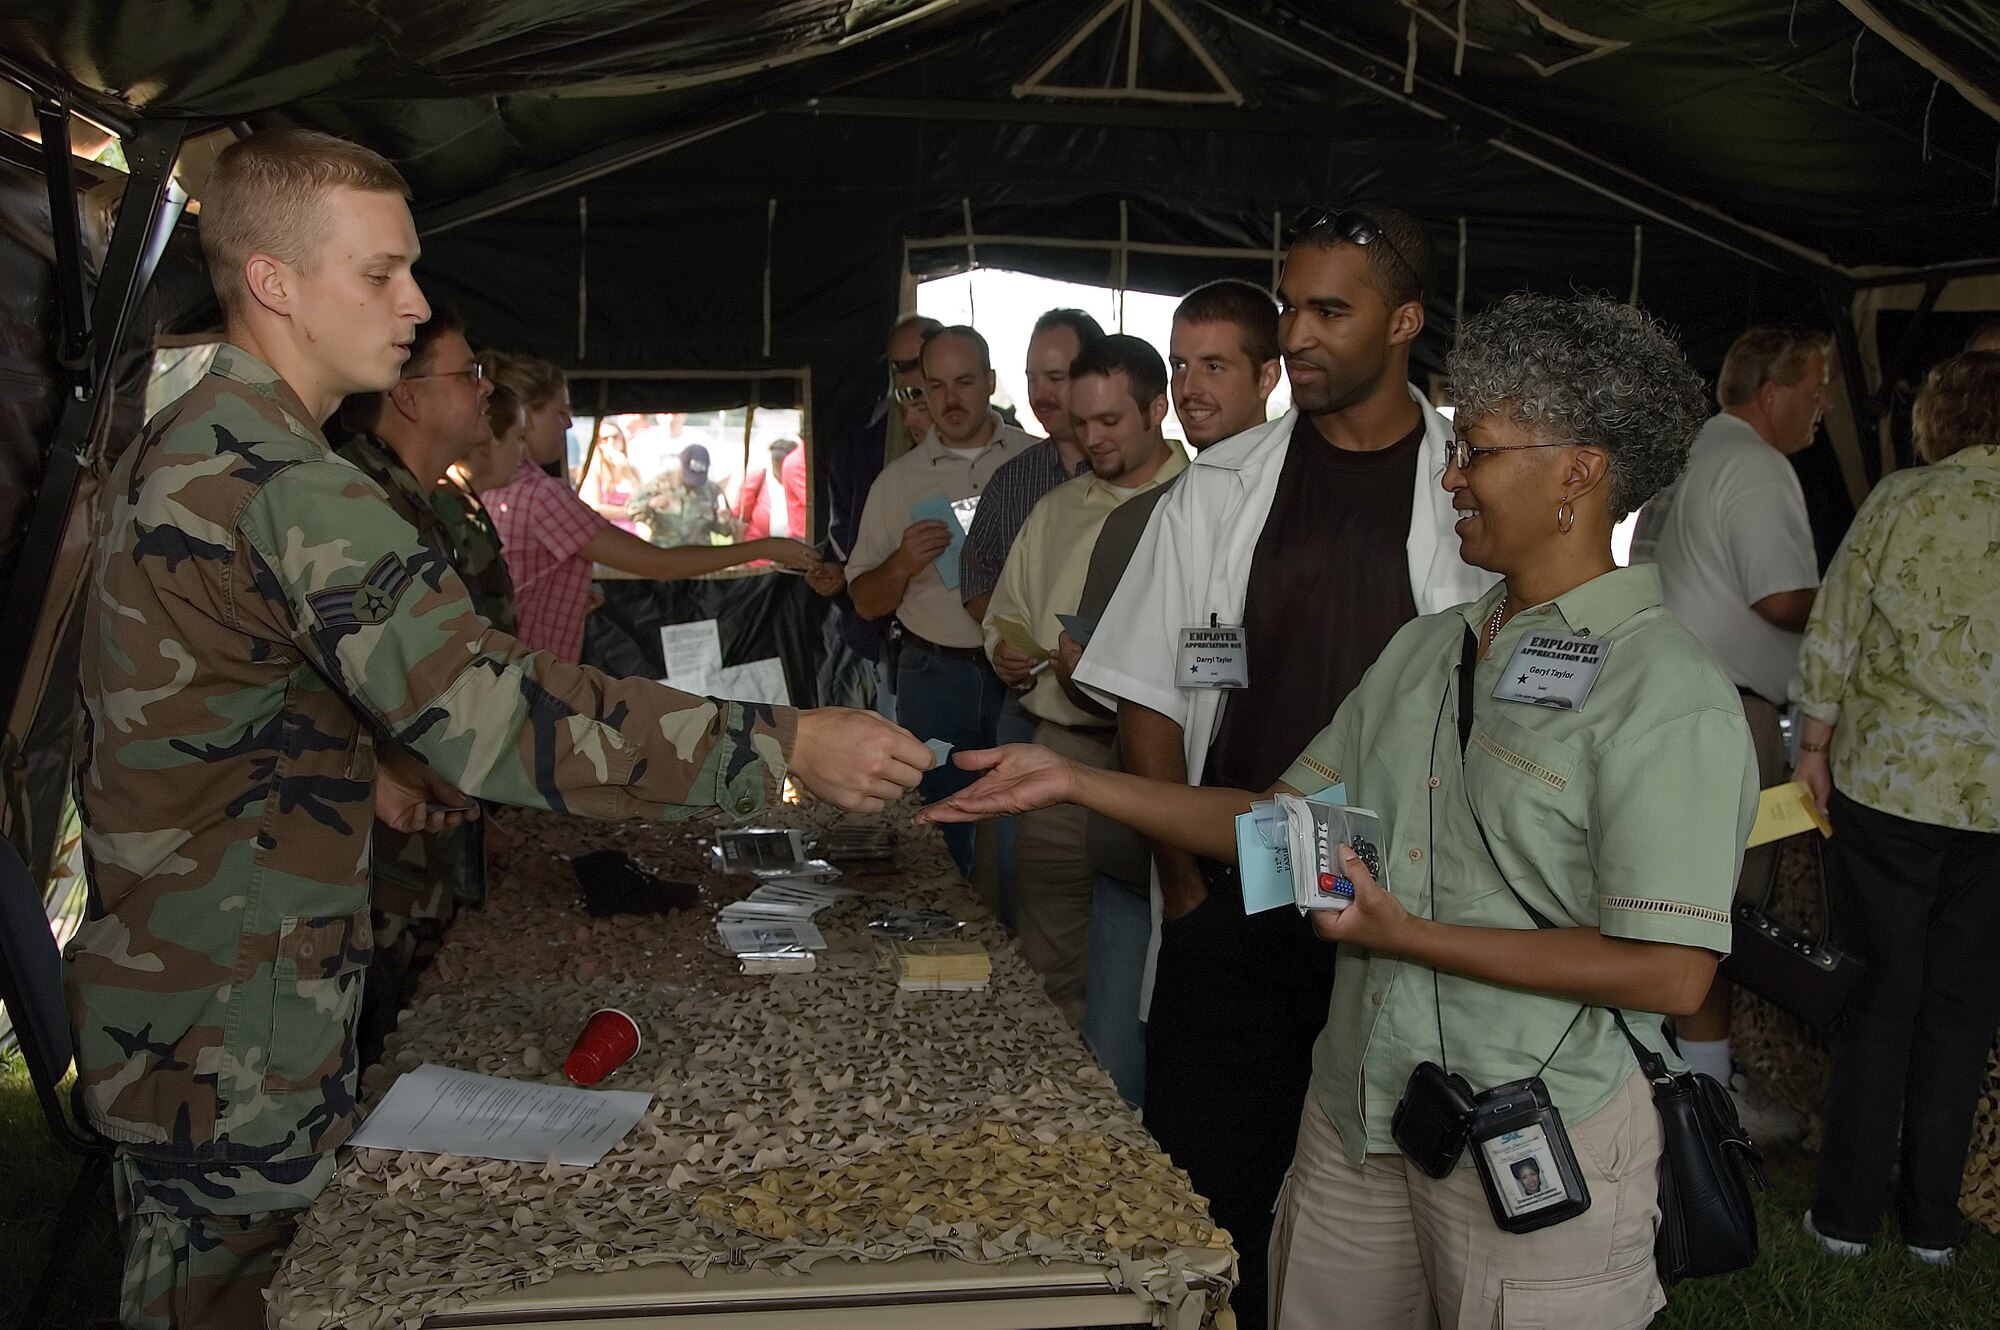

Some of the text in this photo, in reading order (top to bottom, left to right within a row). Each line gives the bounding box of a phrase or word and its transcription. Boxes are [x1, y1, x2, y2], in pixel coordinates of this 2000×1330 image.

[1189, 632, 1237, 641] EMPLOYER
[1529, 636, 1599, 655] EMPLOYER
[1196, 656, 1233, 664] Darryl Taylor
[1520, 648, 1600, 665] APPRECIATION DAY
[1529, 666, 1574, 679] Geryl Taylor
